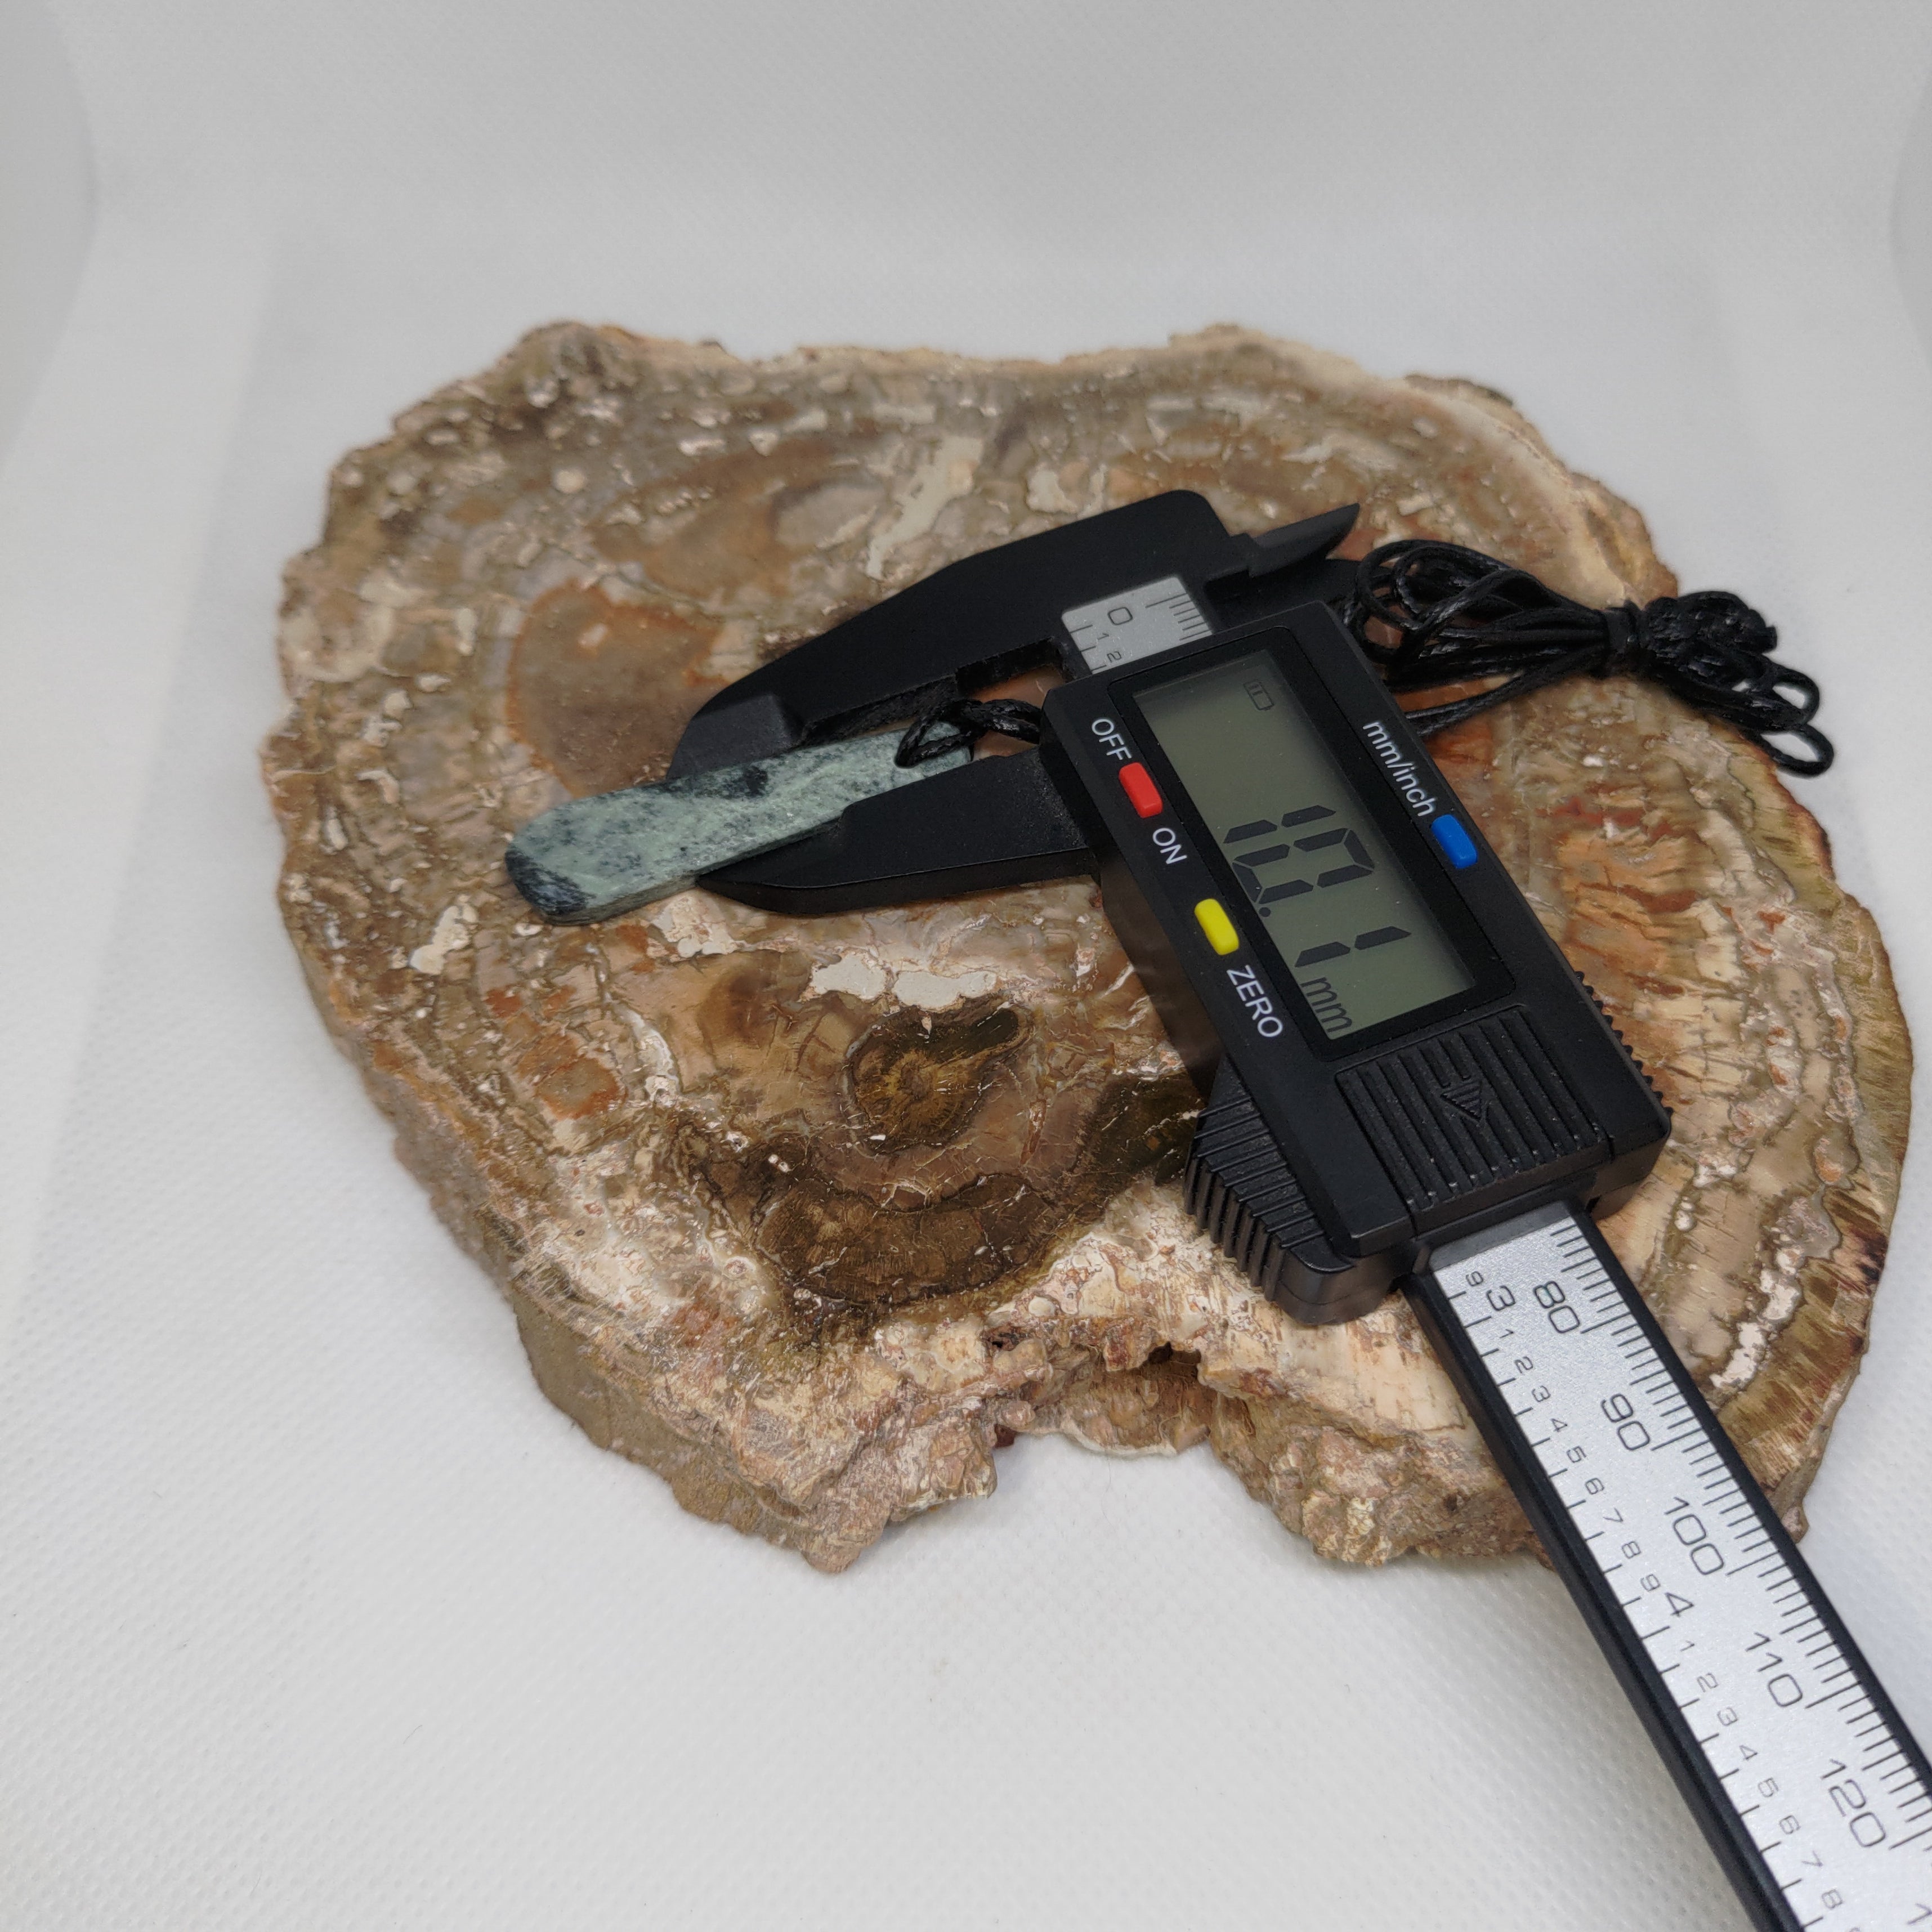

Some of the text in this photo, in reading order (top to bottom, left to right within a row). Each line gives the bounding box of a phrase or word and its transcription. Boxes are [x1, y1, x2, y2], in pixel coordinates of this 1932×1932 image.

[1108, 607, 1133, 625] 0
[1107, 650, 1122, 663] 2
[1091, 718, 1132, 761] OFF
[1362, 721, 1437, 817] mm/inch
[1152, 828, 1187, 865] ON
[1226, 965, 1283, 1037] ZERO
[1300, 977, 1353, 1033] mm
[1486, 1285, 1516, 1312] 3
[1532, 1280, 1580, 1334] 80
[1500, 1329, 1514, 1339] 1
[1514, 1356, 1534, 1374] 2
[1531, 1385, 1551, 1402] 3
[1550, 1417, 1568, 1433] 4
[1600, 1393, 1651, 1451] 90
[1566, 1446, 1587, 1463] 5
[1585, 1478, 1604, 1495] 6
[1603, 1508, 1623, 1523] 7
[1664, 1496, 1725, 1576] 100
[1622, 1541, 1641, 1559] 8
[1640, 1574, 1661, 1592] 9
[1665, 1591, 1695, 1617] 4
[1680, 1640, 1696, 1653] 1
[1745, 1631, 1803, 1708] 110
[1697, 1672, 1719, 1692] 2
[1717, 1707, 1738, 1727] 3
[1739, 1744, 1758, 1761] 4
[1758, 1777, 1779, 1798] 5
[1820, 1758, 1887, 1848] 120
[1779, 1815, 1801, 1835] 6
[1801, 1850, 1823, 1867] 7
[1821, 1889, 1844, 1909] 8
